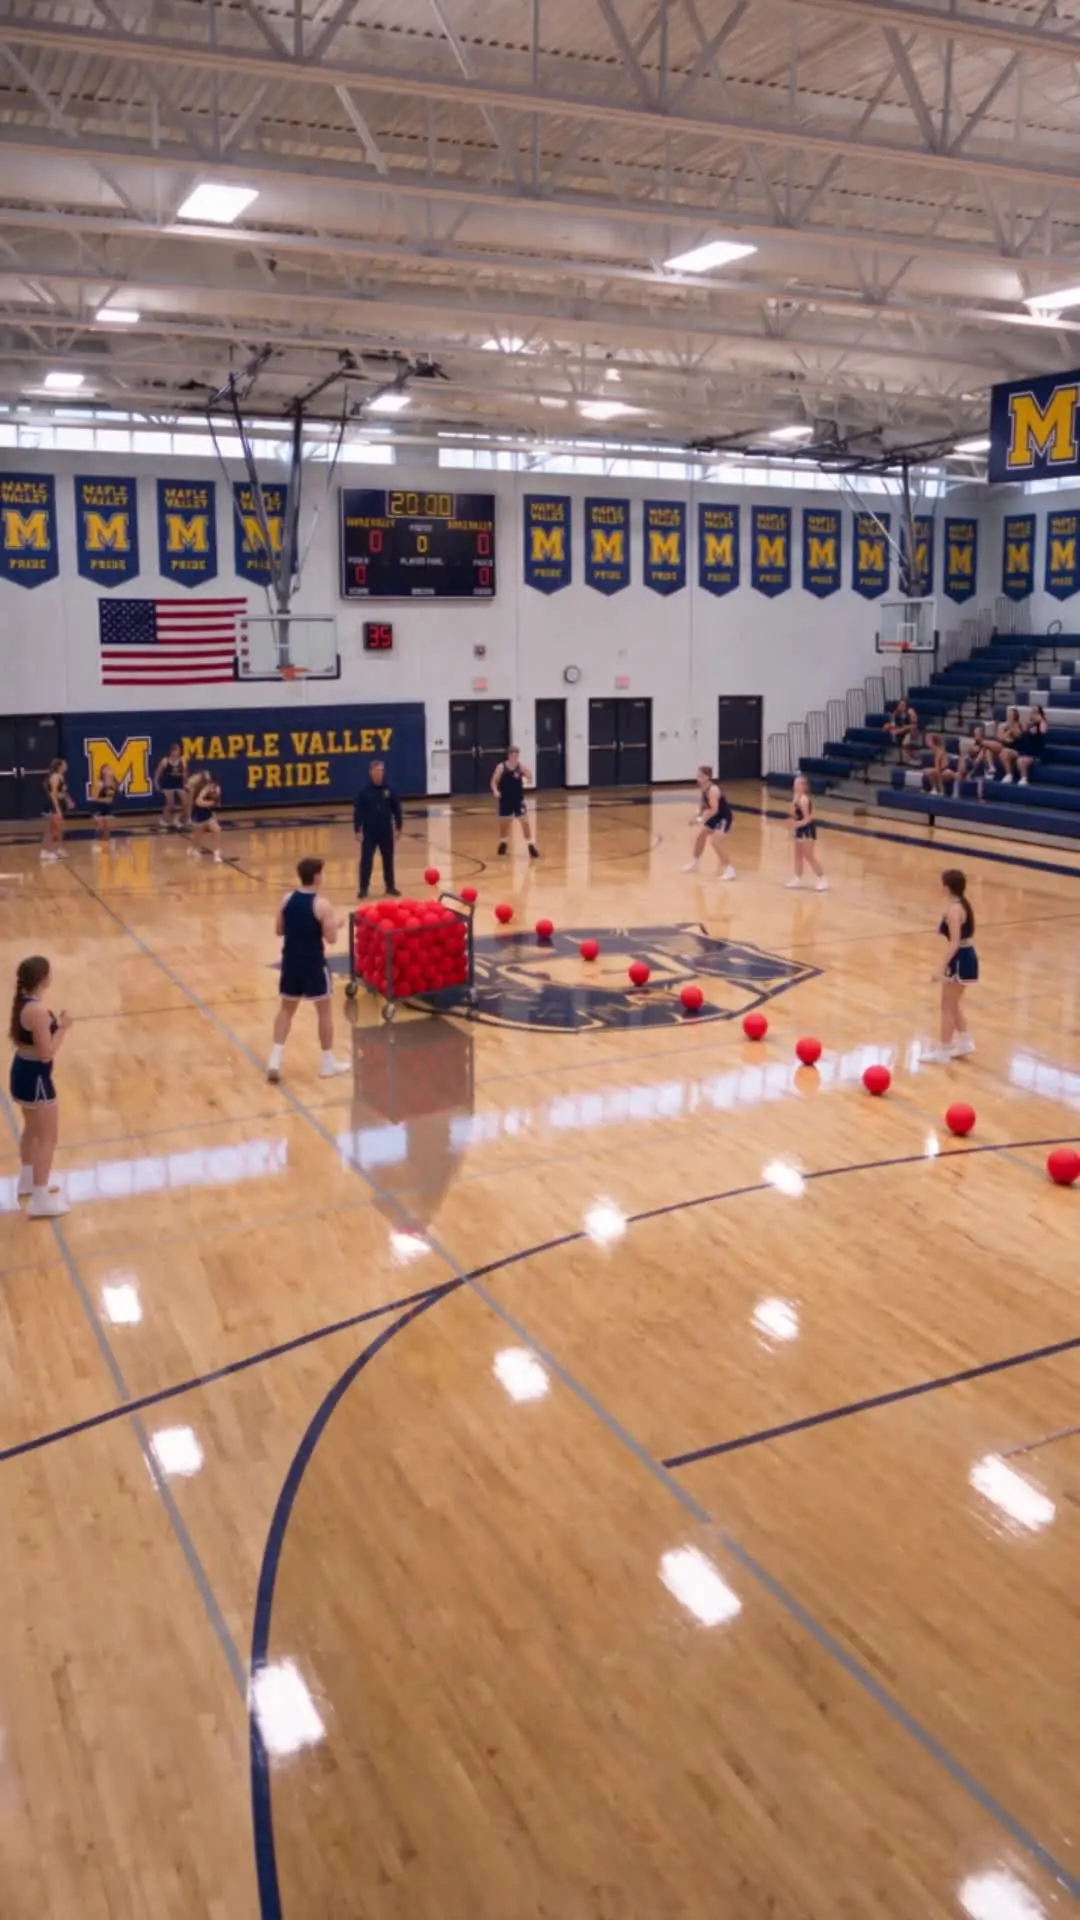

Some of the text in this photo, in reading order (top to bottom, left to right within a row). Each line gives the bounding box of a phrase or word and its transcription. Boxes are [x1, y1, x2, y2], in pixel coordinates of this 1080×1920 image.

[1006, 383, 1080, 470] M
[3, 509, 50, 551] M
[84, 511, 130, 551] M
[165, 514, 209, 552] M
[369, 529, 382, 553] 0
[416, 534, 428, 553] 0
[476, 531, 490, 555] 0
[530, 526, 565, 562] M
[591, 528, 624, 564] M
[648, 530, 680, 565] M
[704, 532, 734, 567] M
[757, 534, 786, 568] M
[808, 536, 836, 569] M
[858, 538, 884, 572] M
[949, 543, 973, 575] M
[1007, 542, 1030, 573] M
[1051, 538, 1076, 571] M
[355, 565, 367, 584] 0
[479, 567, 490, 586] 0
[369, 626, 392, 648] 35
[182, 728, 392, 760] MAPLE VALLEY
[84, 736, 153, 800] M
[247, 761, 331, 788] PRIDE
